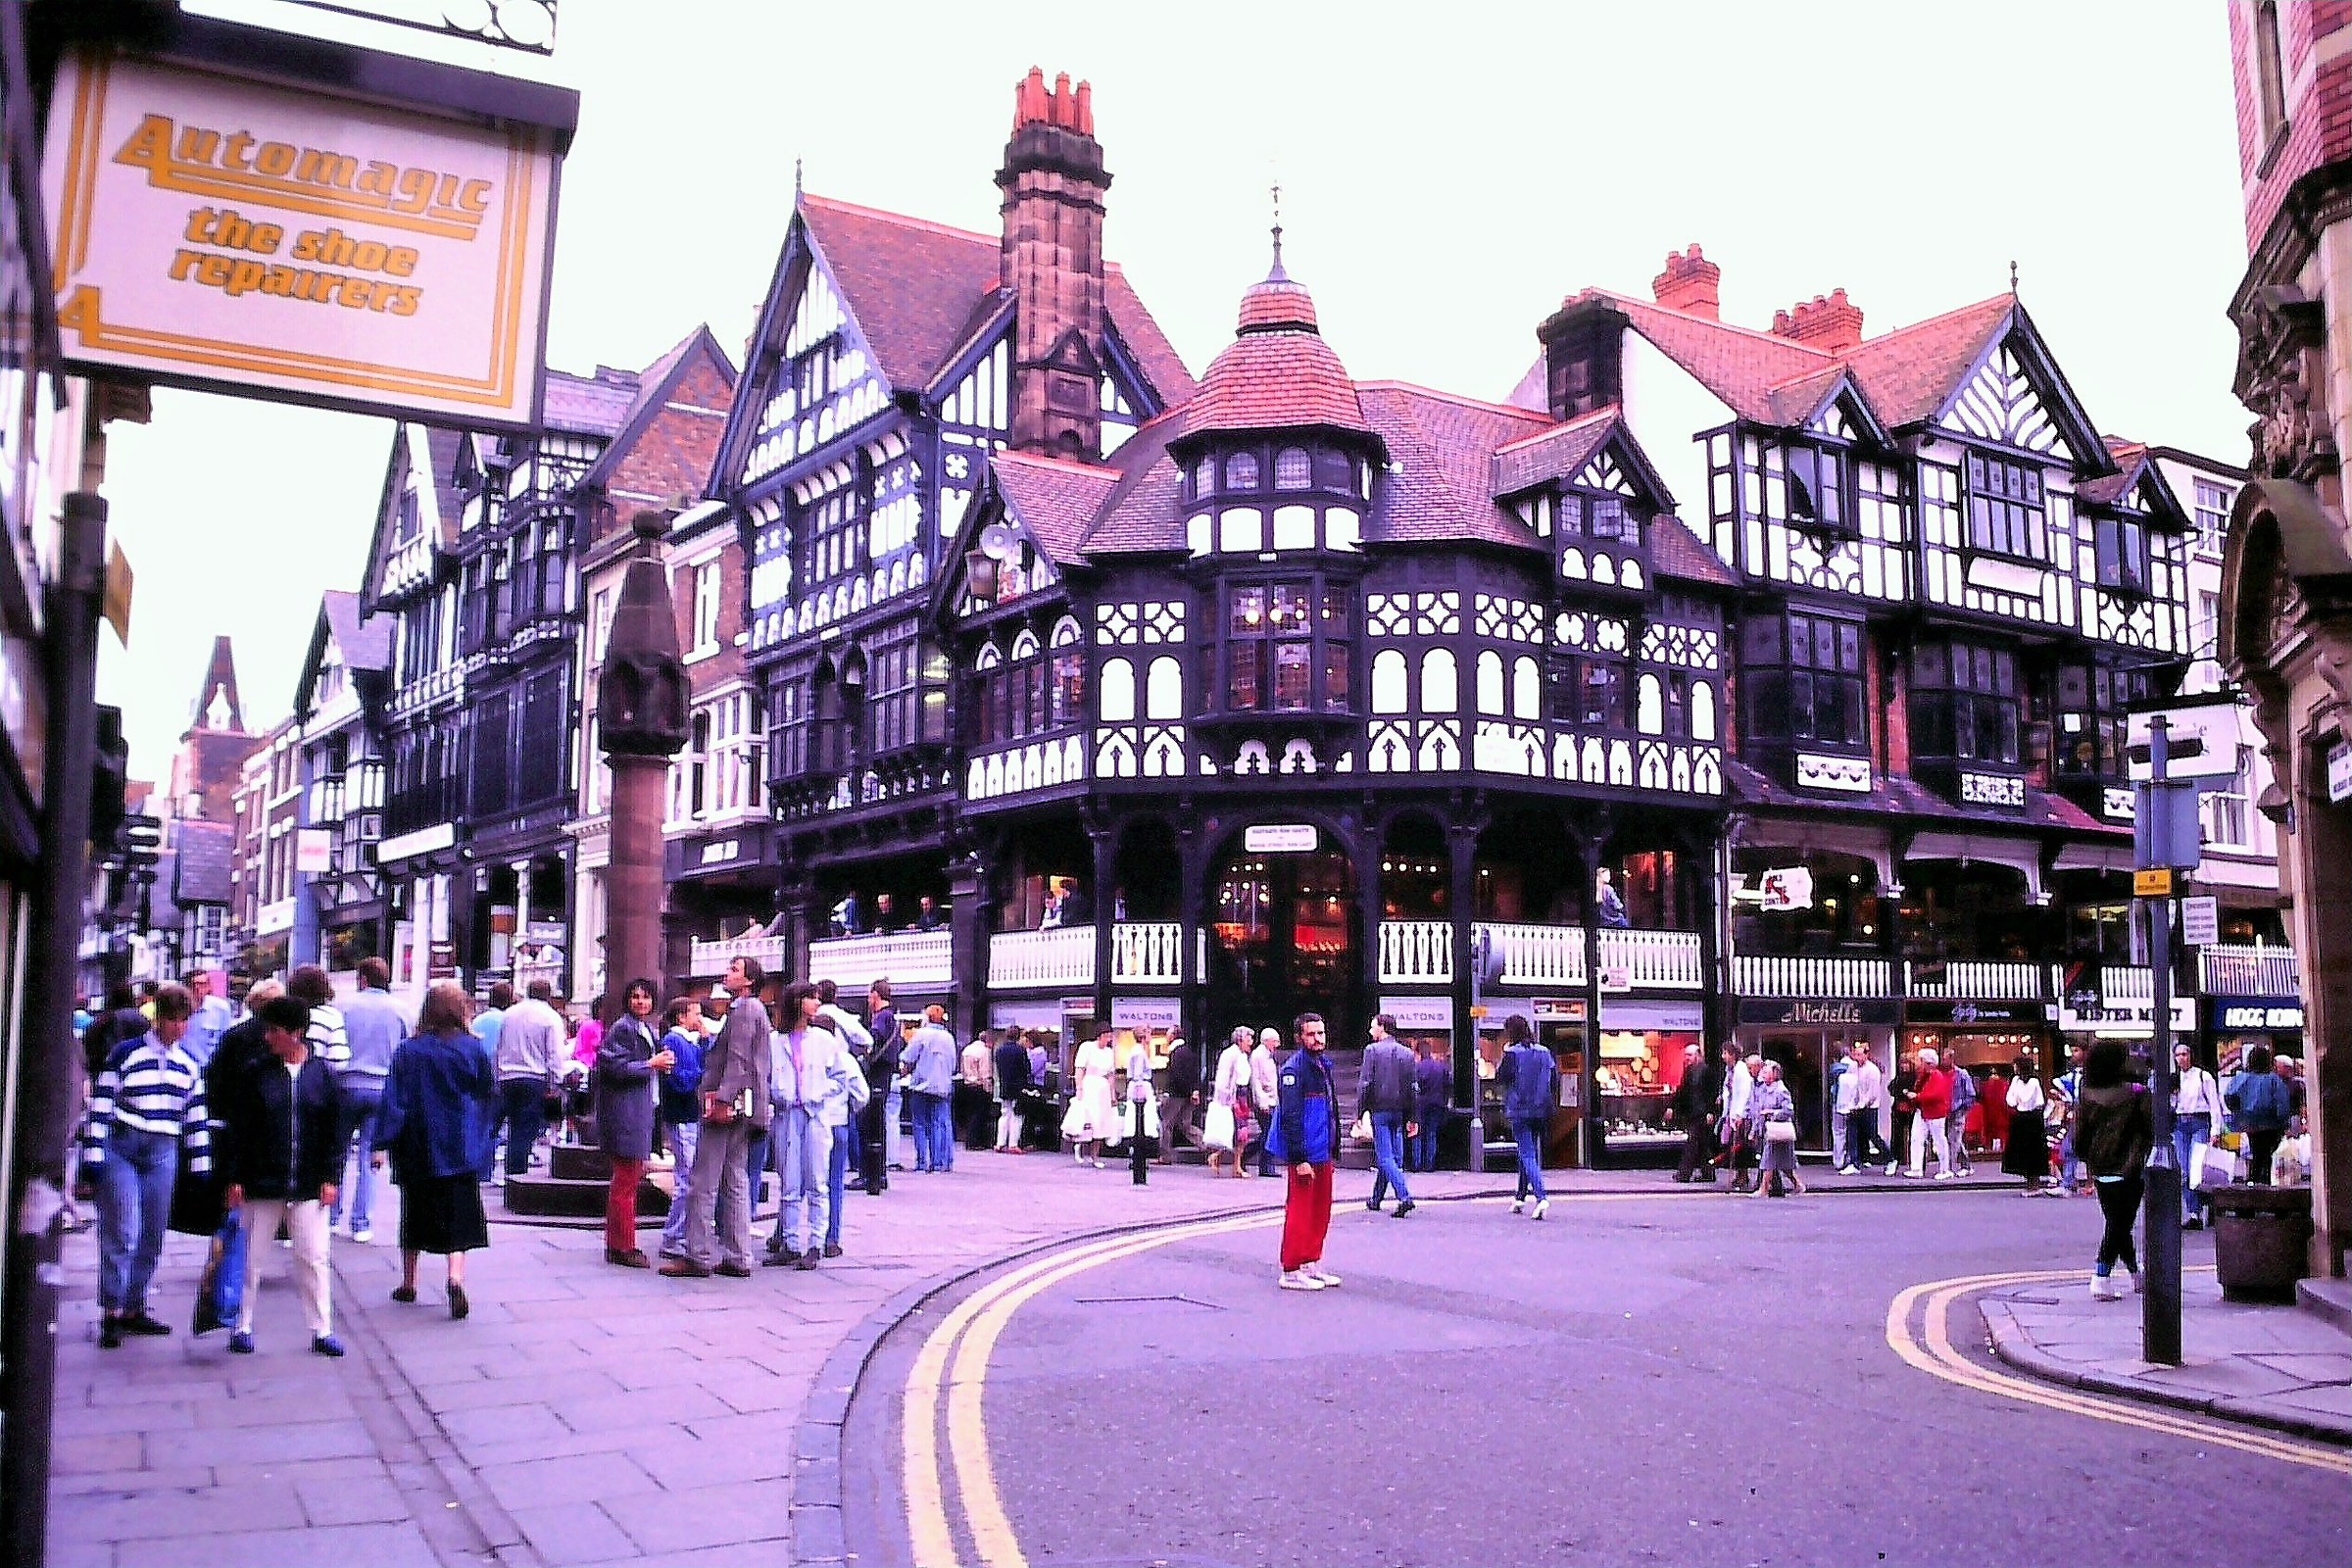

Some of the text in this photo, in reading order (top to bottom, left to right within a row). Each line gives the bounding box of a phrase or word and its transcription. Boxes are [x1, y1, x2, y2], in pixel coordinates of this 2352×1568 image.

[112, 112, 492, 214] Automagic
[185, 207, 419, 277] the shoe
[168, 248, 424, 318] repairers
[1119, 1012, 1173, 1021] WALTONS
[2077, 1008, 2133, 1021] MISTER
[2226, 1007, 2265, 1027] HOGG
